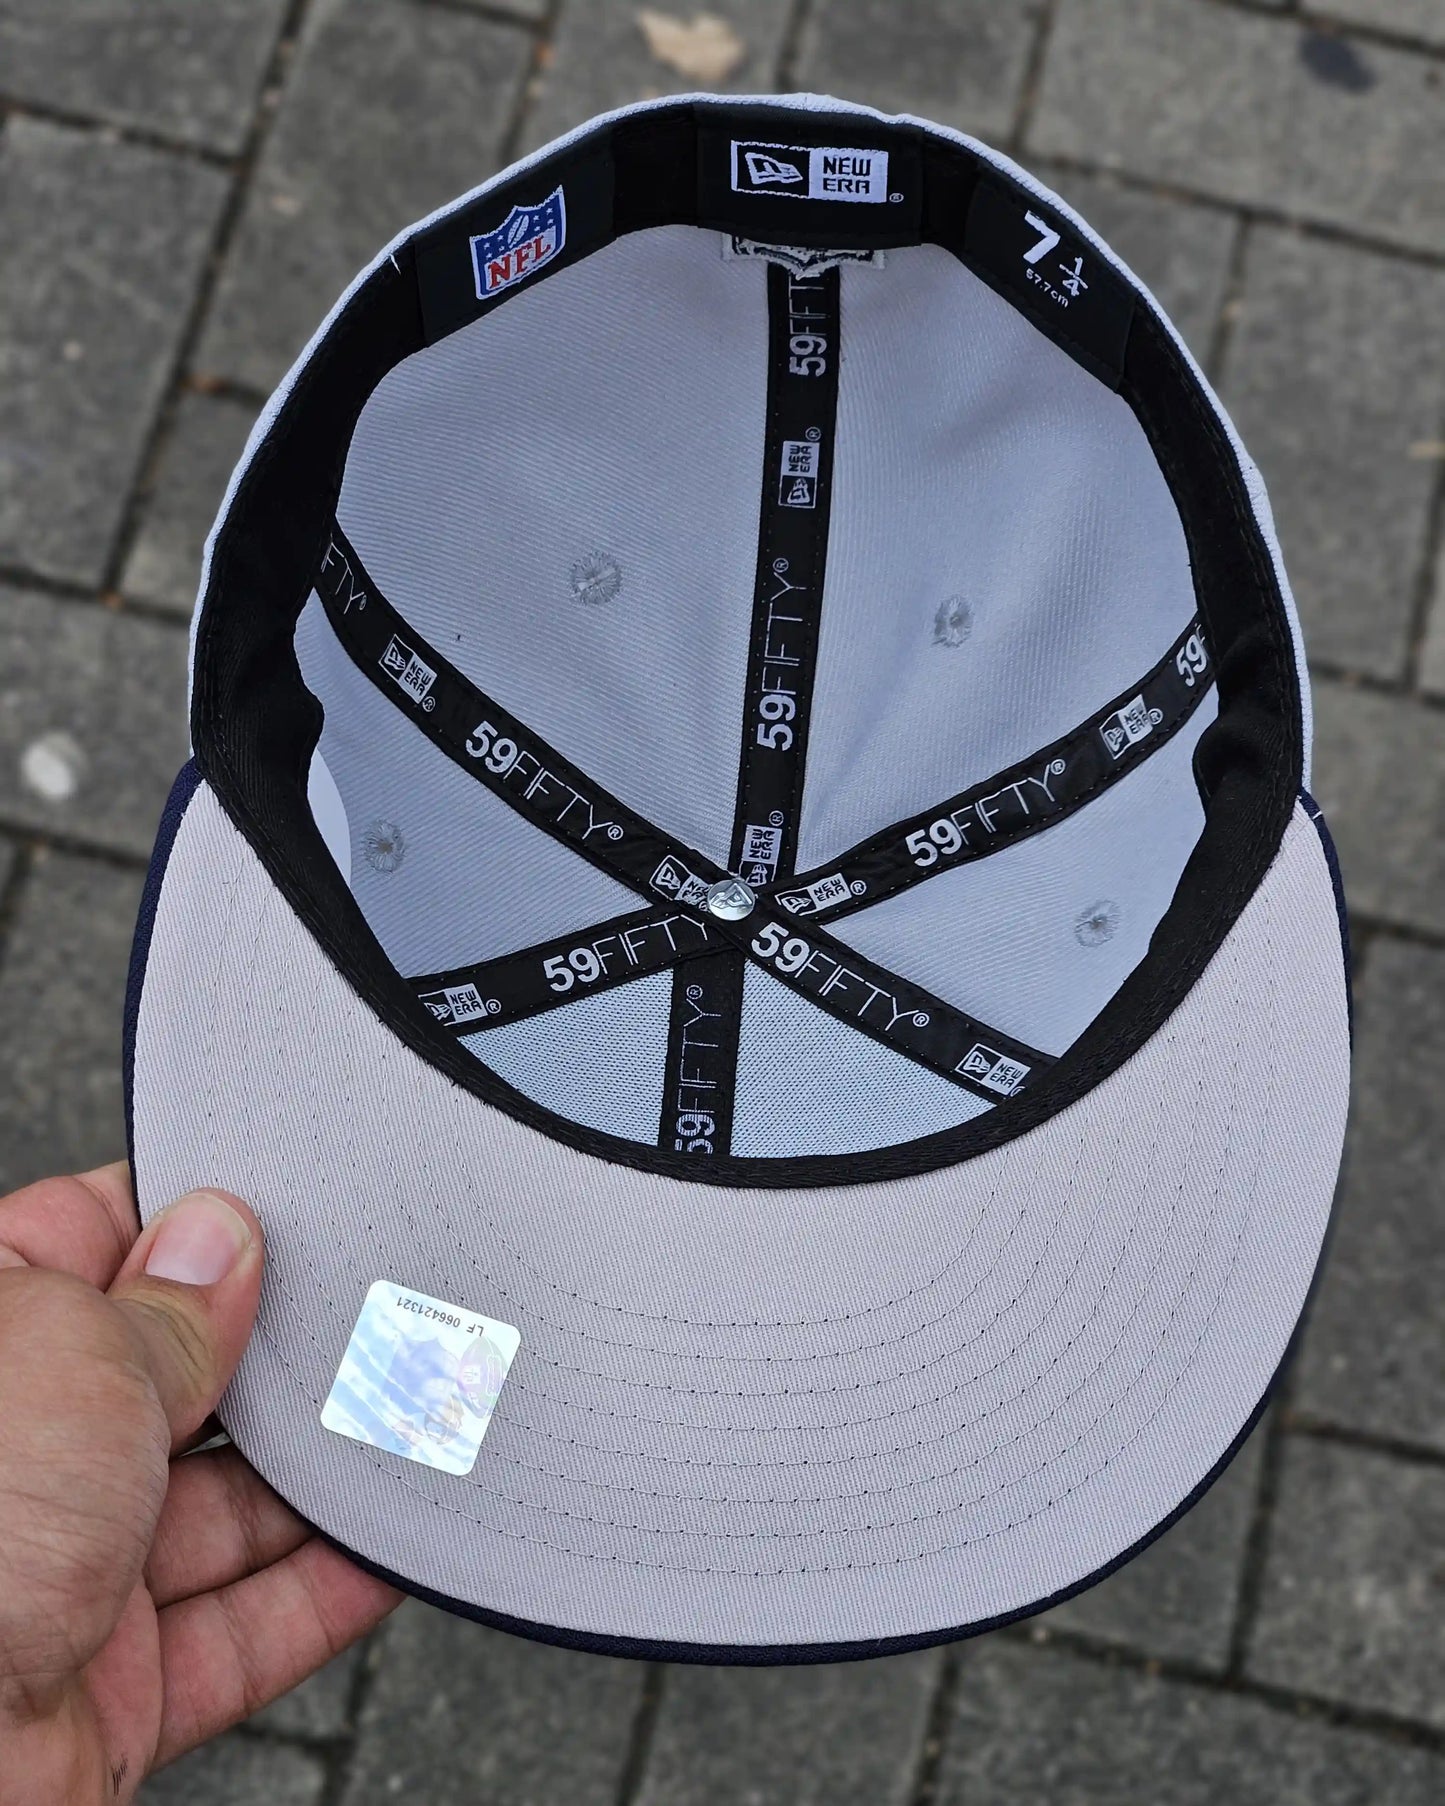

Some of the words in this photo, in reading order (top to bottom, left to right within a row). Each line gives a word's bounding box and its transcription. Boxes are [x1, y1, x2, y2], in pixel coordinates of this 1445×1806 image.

[822, 155, 872, 177] NEW
[822, 177, 871, 195] ERA
[1023, 209, 1061, 264] 7
[487, 235, 551, 289] NFL
[788, 271, 828, 378] 59FIFT
[788, 443, 800, 473] NEW
[800, 444, 812, 474] ERA
[404, 673, 426, 697] ERA
[409, 659, 432, 687] NEW
[748, 828, 764, 859] NEW
[761, 829, 776, 861] ERA
[813, 877, 842, 895] NEW
[817, 884, 847, 902] ERA
[449, 988, 477, 1005] NEW
[454, 999, 483, 1016] ERA
[989, 1072, 1016, 1089] ERA
[997, 1062, 1024, 1080] NEW
[396, 1296, 461, 1328] 066421321
[465, 1323, 485, 1337] LF
